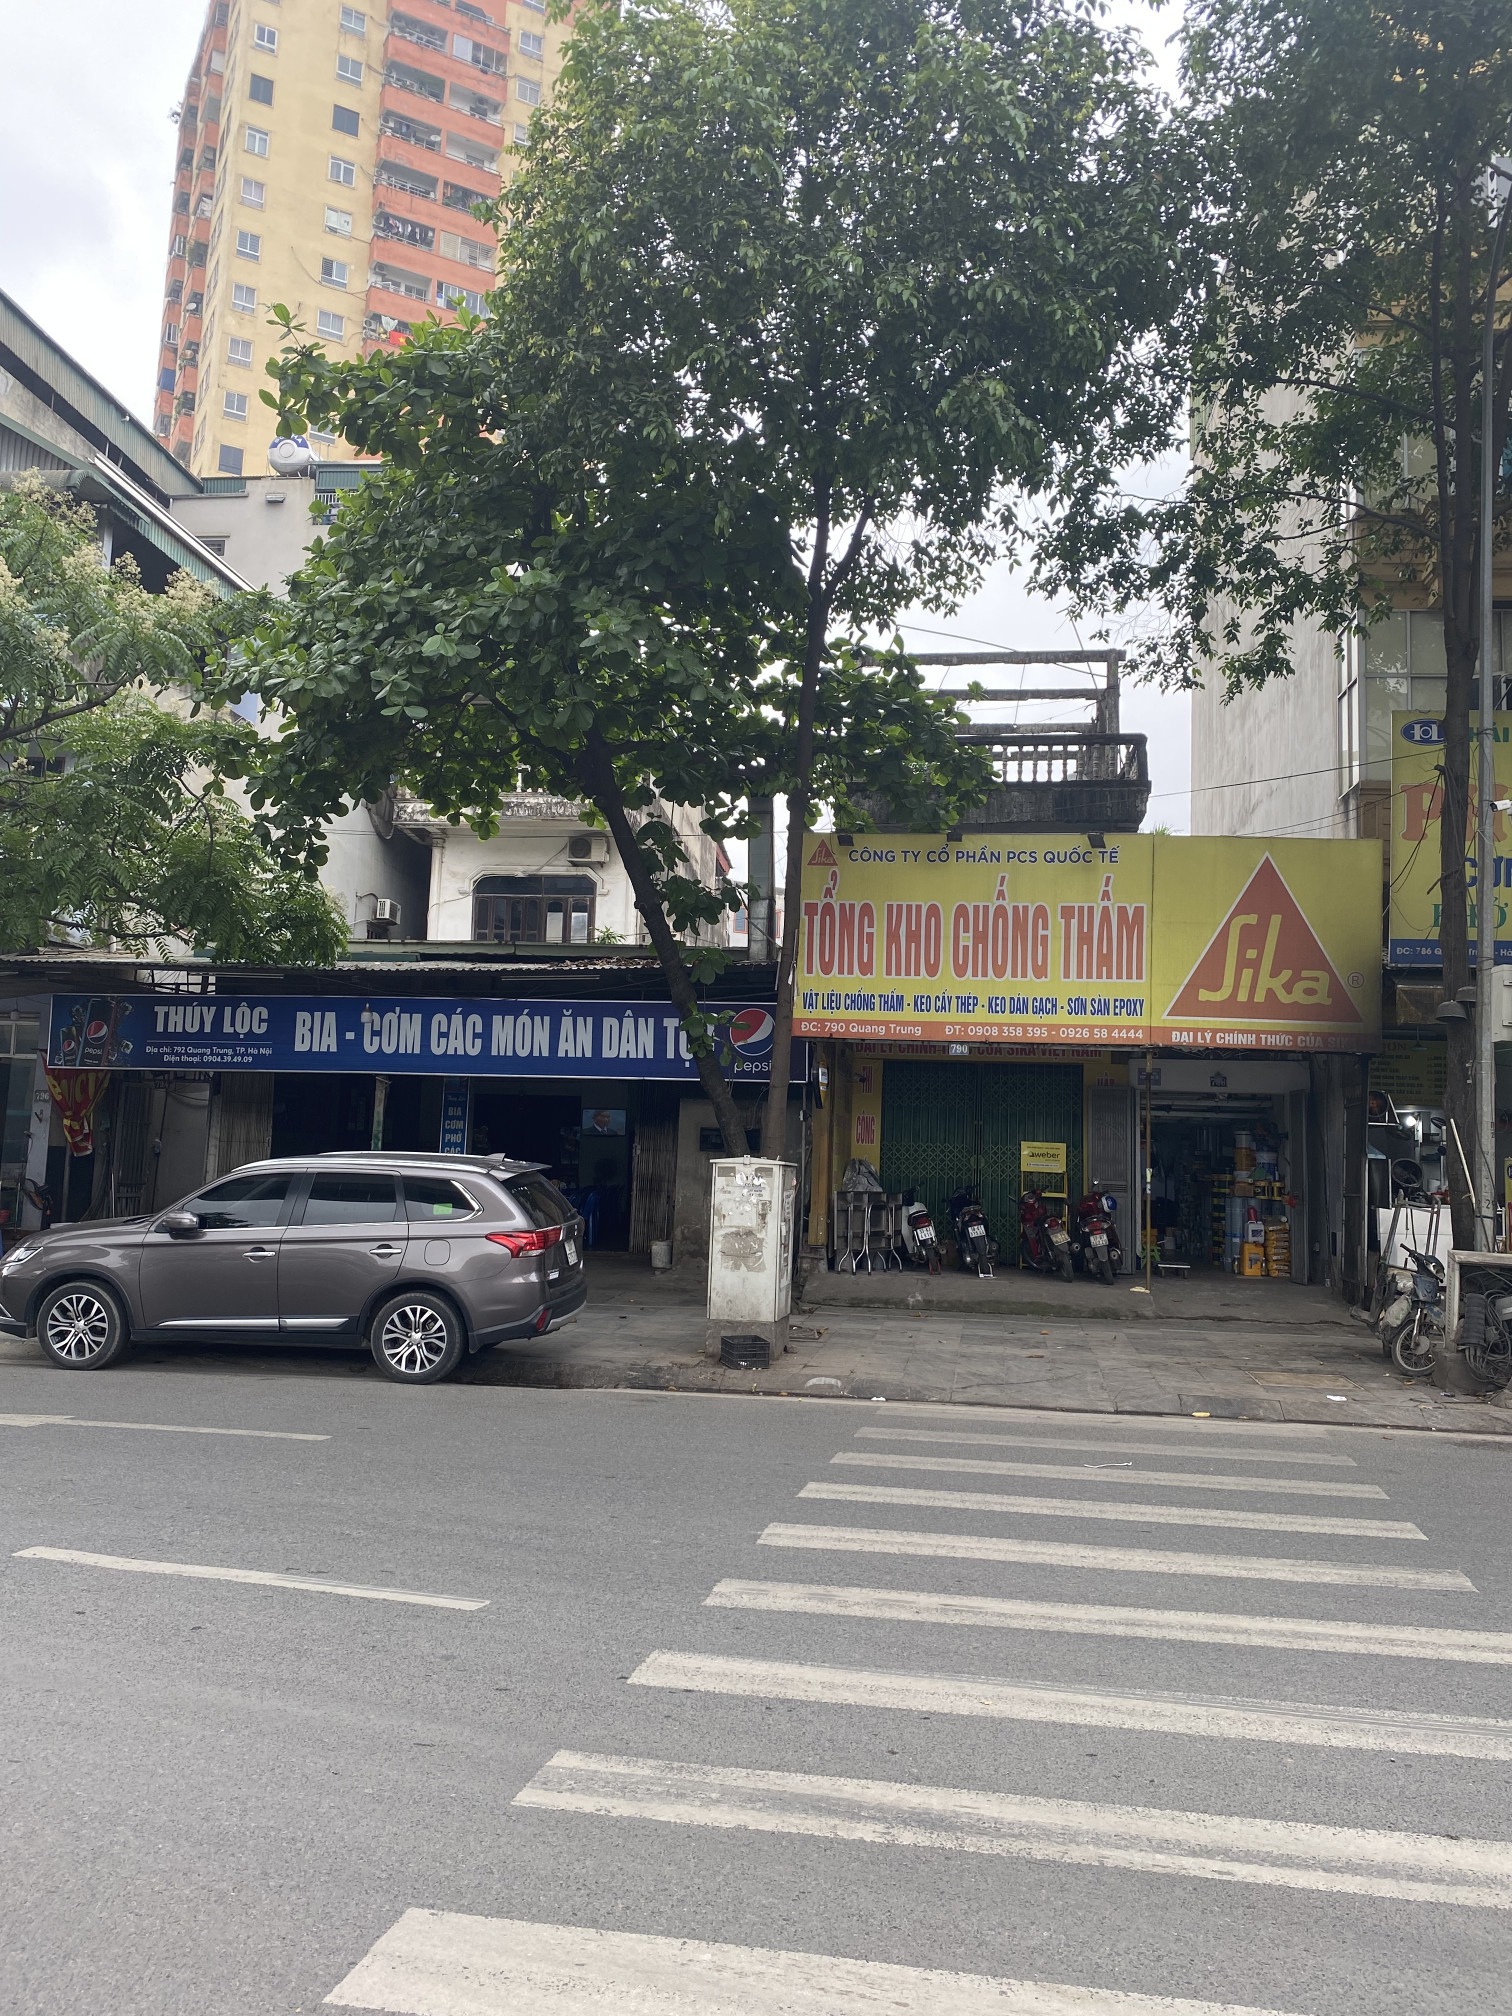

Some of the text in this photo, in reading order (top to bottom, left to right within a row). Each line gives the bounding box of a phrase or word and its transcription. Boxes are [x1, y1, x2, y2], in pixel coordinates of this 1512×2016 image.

[811, 847, 834, 864] Sika
[848, 844, 1121, 864] CÔNG TY CỔ PHẦN PCS QUỐC TẾ
[803, 869, 1146, 982] TỔNG KHO CHỐNG THẤM
[1199, 914, 1332, 1004] Sika
[802, 988, 820, 1014] VẬT
[821, 989, 841, 1015] LIỆU
[844, 987, 875, 1012] CHỐNG
[878, 988, 905, 1013] THẤM
[913, 993, 931, 1013] KEO
[934, 989, 952, 1014] CẤY
[955, 991, 979, 1015] THÉP
[987, 995, 1006, 1015] KEO
[1009, 993, 1029, 1016] DÁN
[1031, 996, 1058, 1019] GẠCH
[1067, 995, 1088, 1017] SƠN
[1090, 994, 1110, 1017] SÀN
[1113, 998, 1145, 1018] EPOXY
[154, 1001, 269, 1039] THÚY LỘC
[294, 1011, 338, 1053] BIA
[362, 1007, 423, 1055] CƠM
[430, 1008, 483, 1056] CÁC
[491, 1008, 550, 1058] MÓN
[557, 1009, 594, 1059] ĂN
[602, 1010, 655, 1060] DÂN
[801, 1021, 821, 1032] ĐC:
[824, 1022, 846, 1033] 790
[849, 1022, 886, 1036] Quang
[889, 1023, 922, 1036] Trung
[944, 1025, 965, 1036] ĐT:
[967, 1025, 999, 1037] 0908
[1001, 1026, 1023, 1037] 358
[1026, 1026, 1048, 1038] 395
[1059, 1027, 1090, 1039] 0926
[1093, 1028, 1109, 1039] 58
[1111, 1028, 1144, 1040] 4444
[1171, 1030, 1194, 1046] ĐẠI
[1197, 1029, 1213, 1044] LÝ
[1216, 1030, 1256, 1046] CHÍNH
[1260, 1032, 1293, 1048] THỨC
[1297, 1033, 1324, 1049] CỦA
[84, 1047, 103, 1055] pepsi
[173, 1046, 186, 1054] 792
[187, 1047, 211, 1056] Quang
[950, 1044, 968, 1053] 790
[734, 1060, 773, 1074] pepsi
[448, 1107, 462, 1116] BIA
[445, 1119, 464, 1130] CƠM
[855, 1109, 876, 1145] CÔNG
[445, 1131, 463, 1143] PHỞ
[1034, 1151, 1061, 1159] weber
